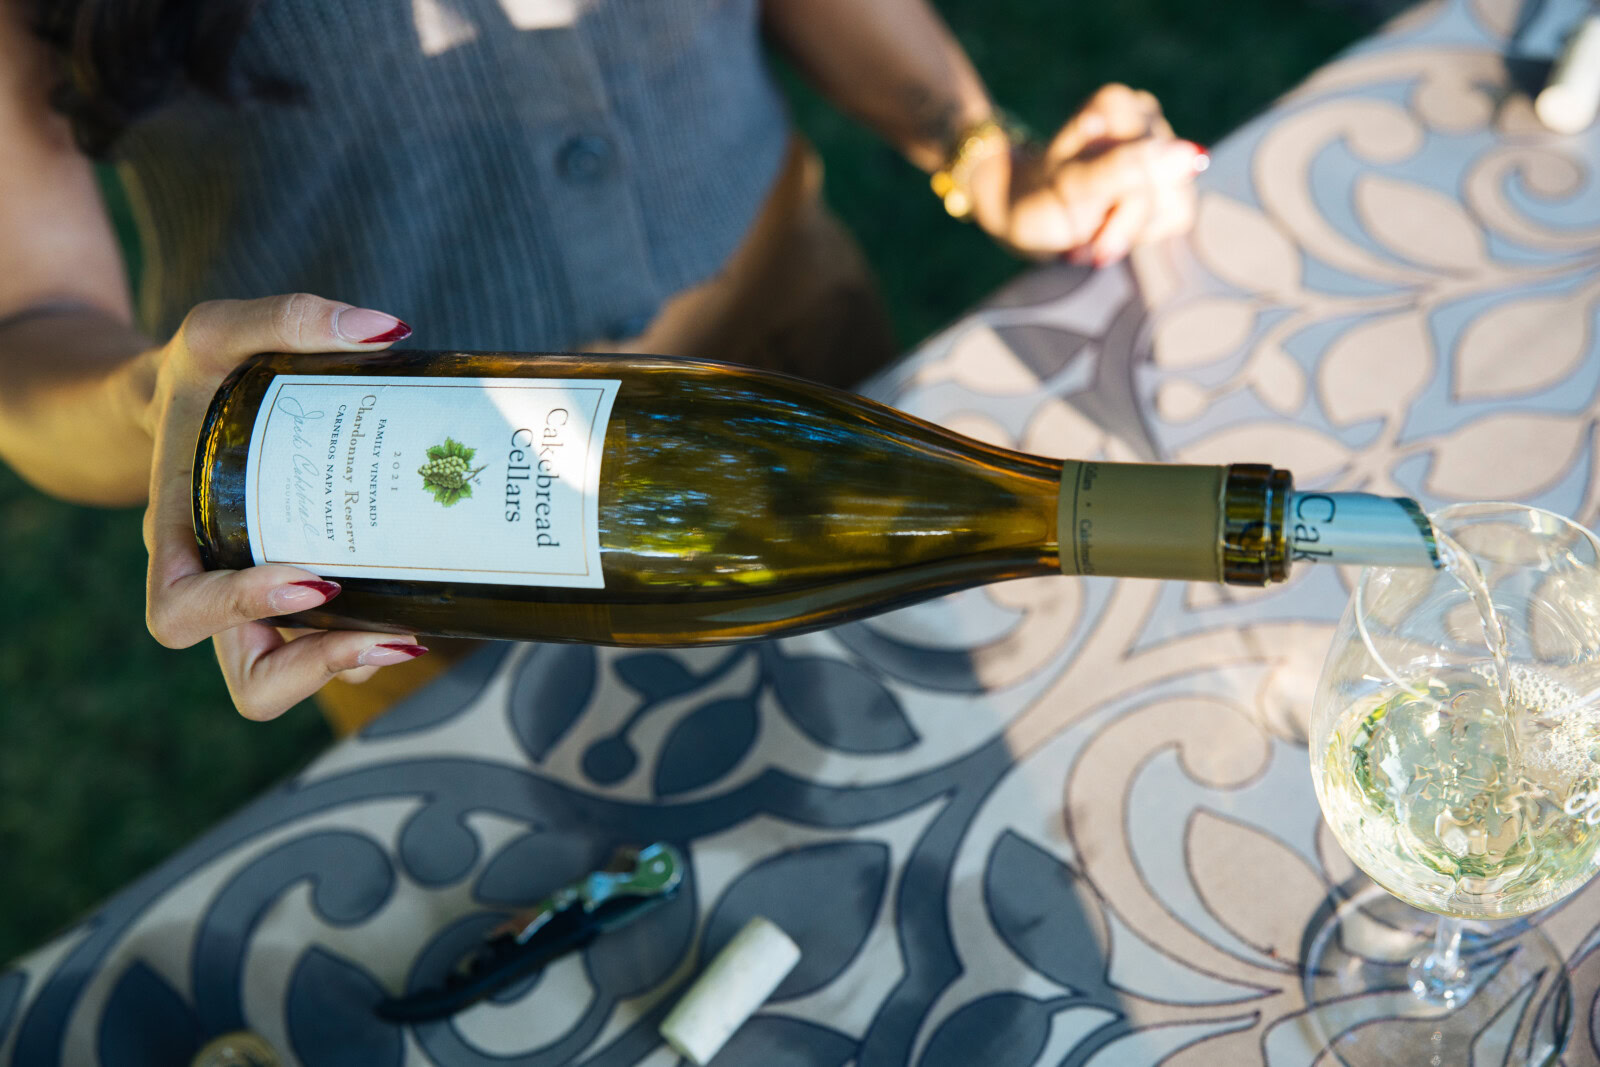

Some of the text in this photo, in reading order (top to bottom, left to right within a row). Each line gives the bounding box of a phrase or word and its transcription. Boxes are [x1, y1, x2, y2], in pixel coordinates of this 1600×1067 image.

[325, 404, 347, 541] CARNEROS NAPA VALLEY
[342, 394, 377, 553] Chardonnay Reserve
[369, 418, 387, 527] FAMILY VINEYARDS
[390, 451, 402, 491] 2021
[505, 428, 533, 522] Cellars
[535, 408, 569, 548] Cakebread
